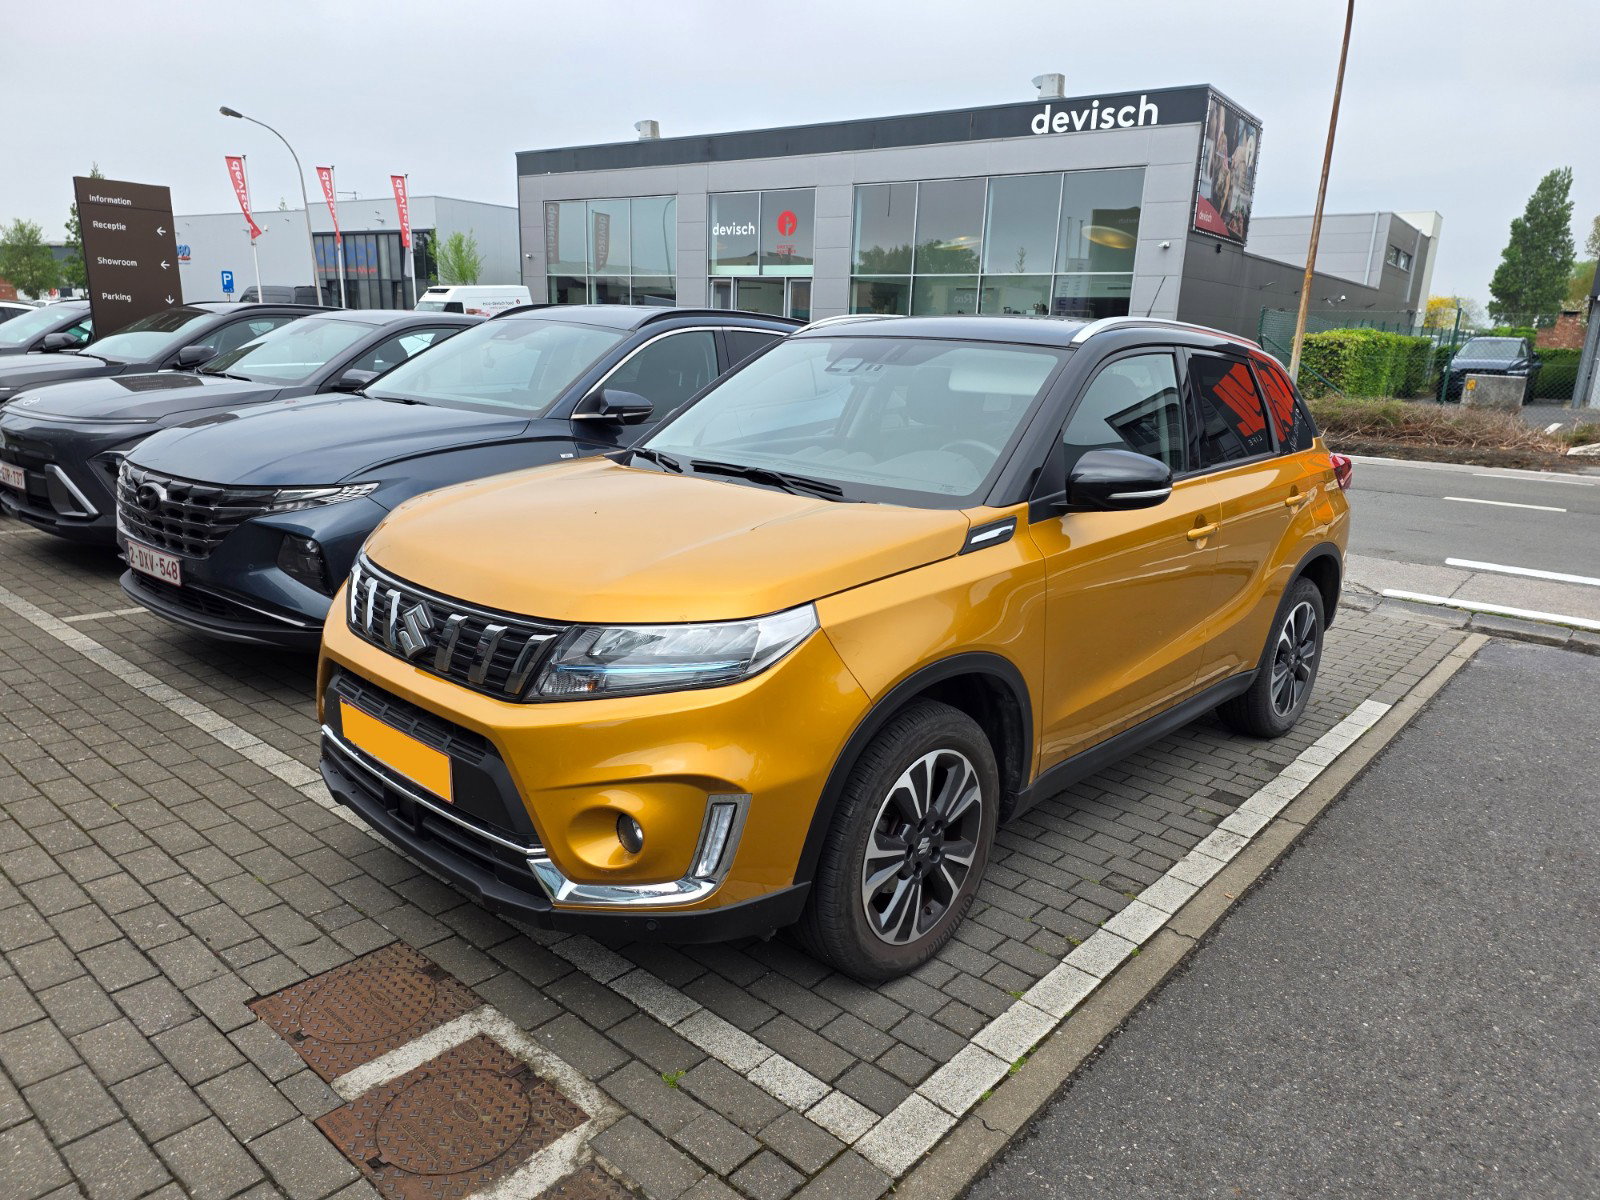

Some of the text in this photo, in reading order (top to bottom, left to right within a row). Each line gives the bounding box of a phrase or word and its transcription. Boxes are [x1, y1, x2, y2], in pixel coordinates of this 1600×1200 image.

[1031, 95, 1159, 135] devisch
[89, 194, 132, 206] Information
[92, 220, 127, 231] Receptie
[712, 222, 755, 235] devisch
[97, 256, 138, 267] Showroom
[223, 273, 231, 285] P
[102, 292, 132, 303] Parking
